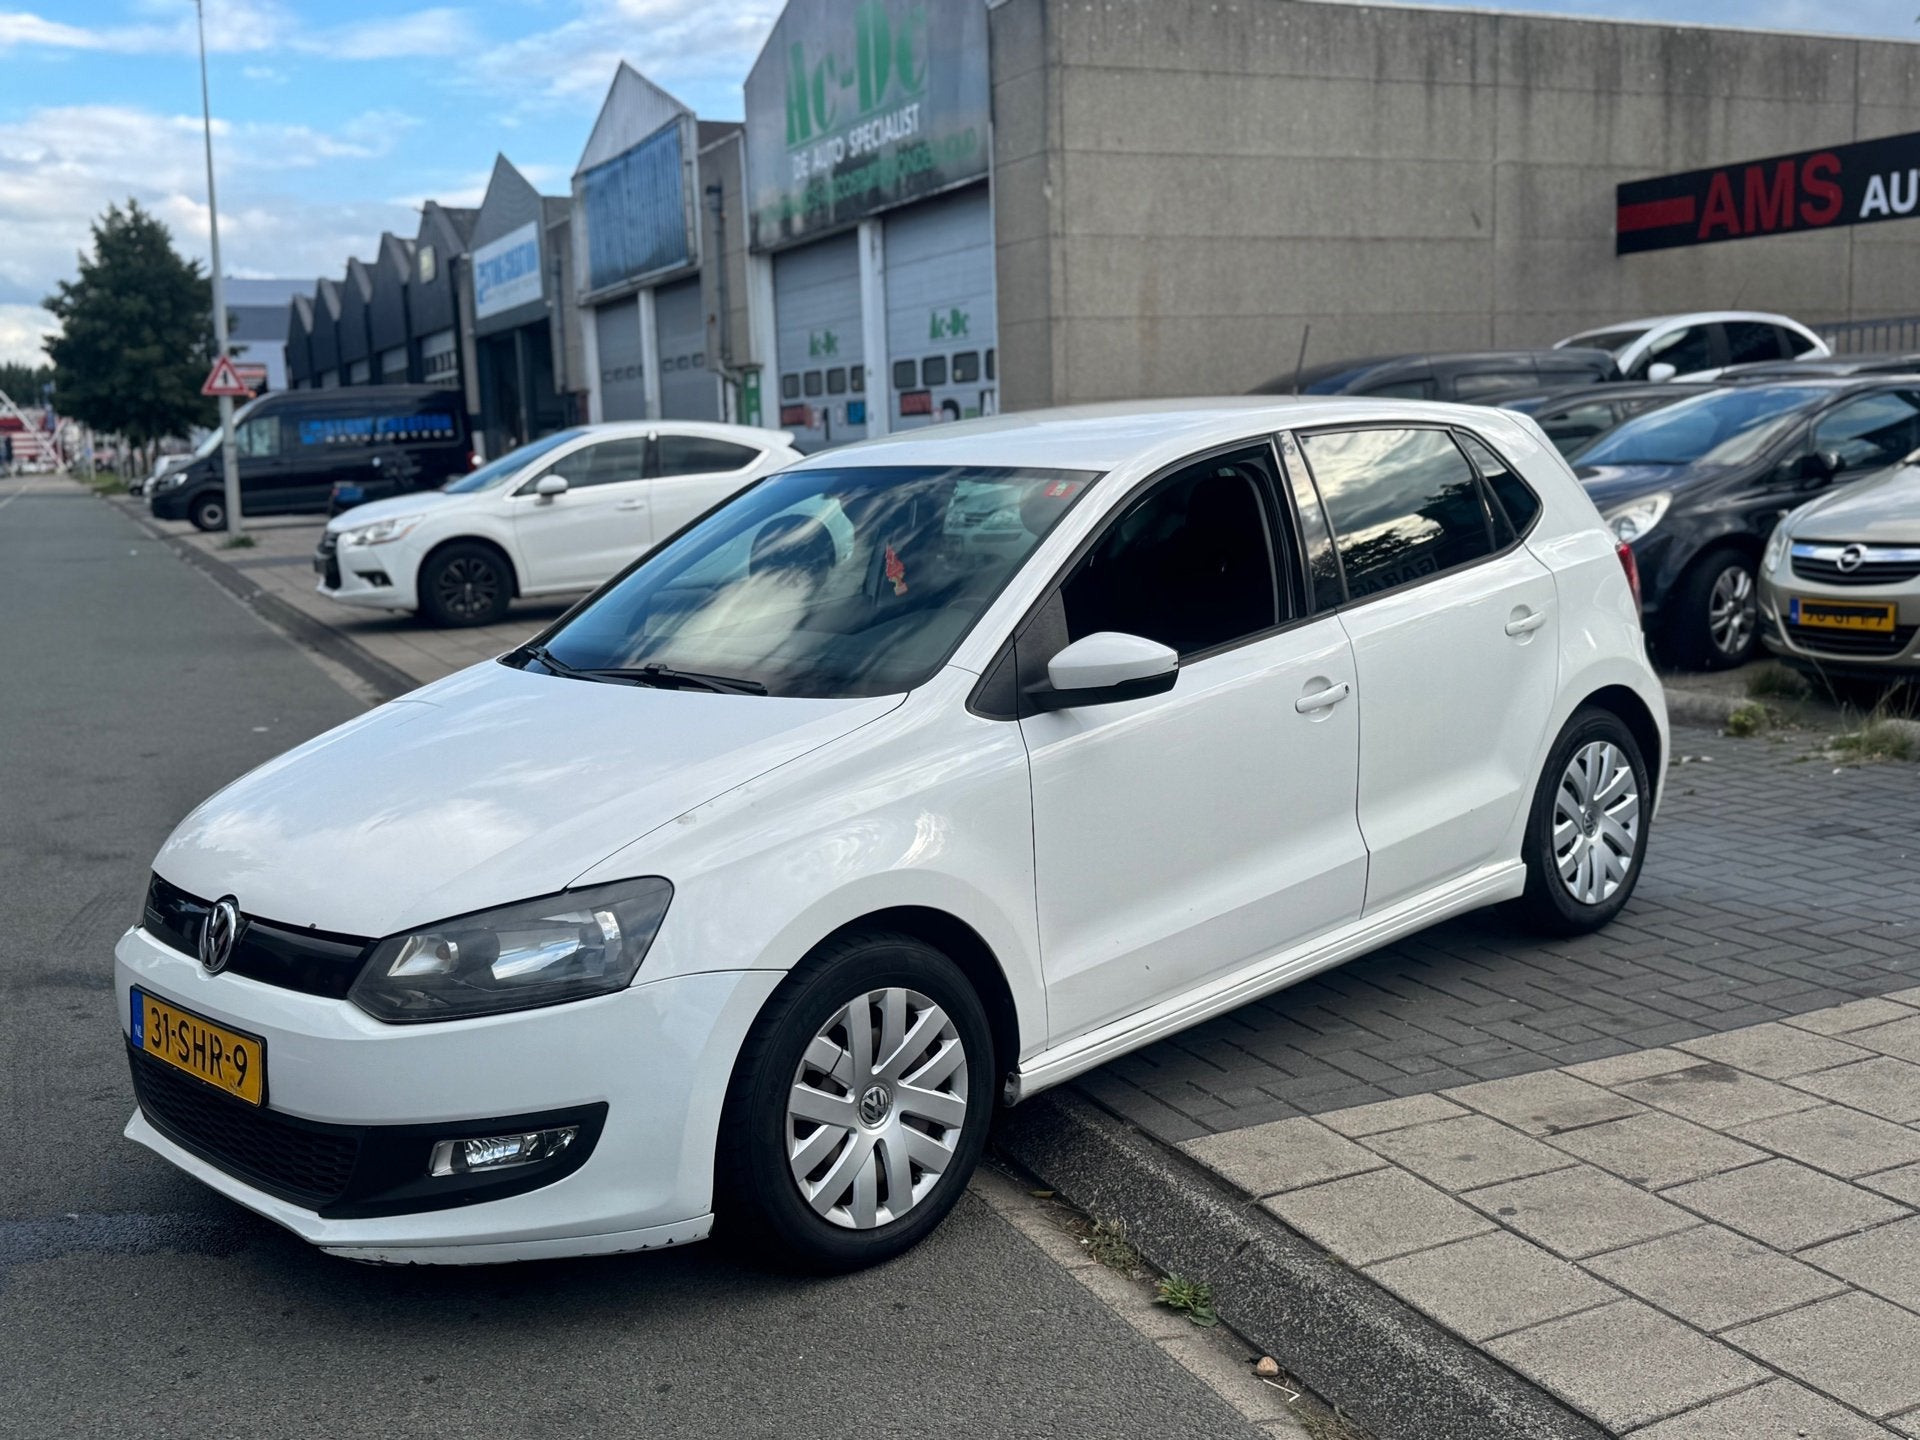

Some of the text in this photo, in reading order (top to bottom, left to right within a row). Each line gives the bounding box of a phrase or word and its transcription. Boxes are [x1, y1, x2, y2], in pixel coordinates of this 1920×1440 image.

[814, 136, 846, 169] AUTO
[849, 103, 920, 157] SPECIALIST
[1697, 152, 1920, 239] AMS AU
[151, 1007, 248, 1089] 31-SHR-9
